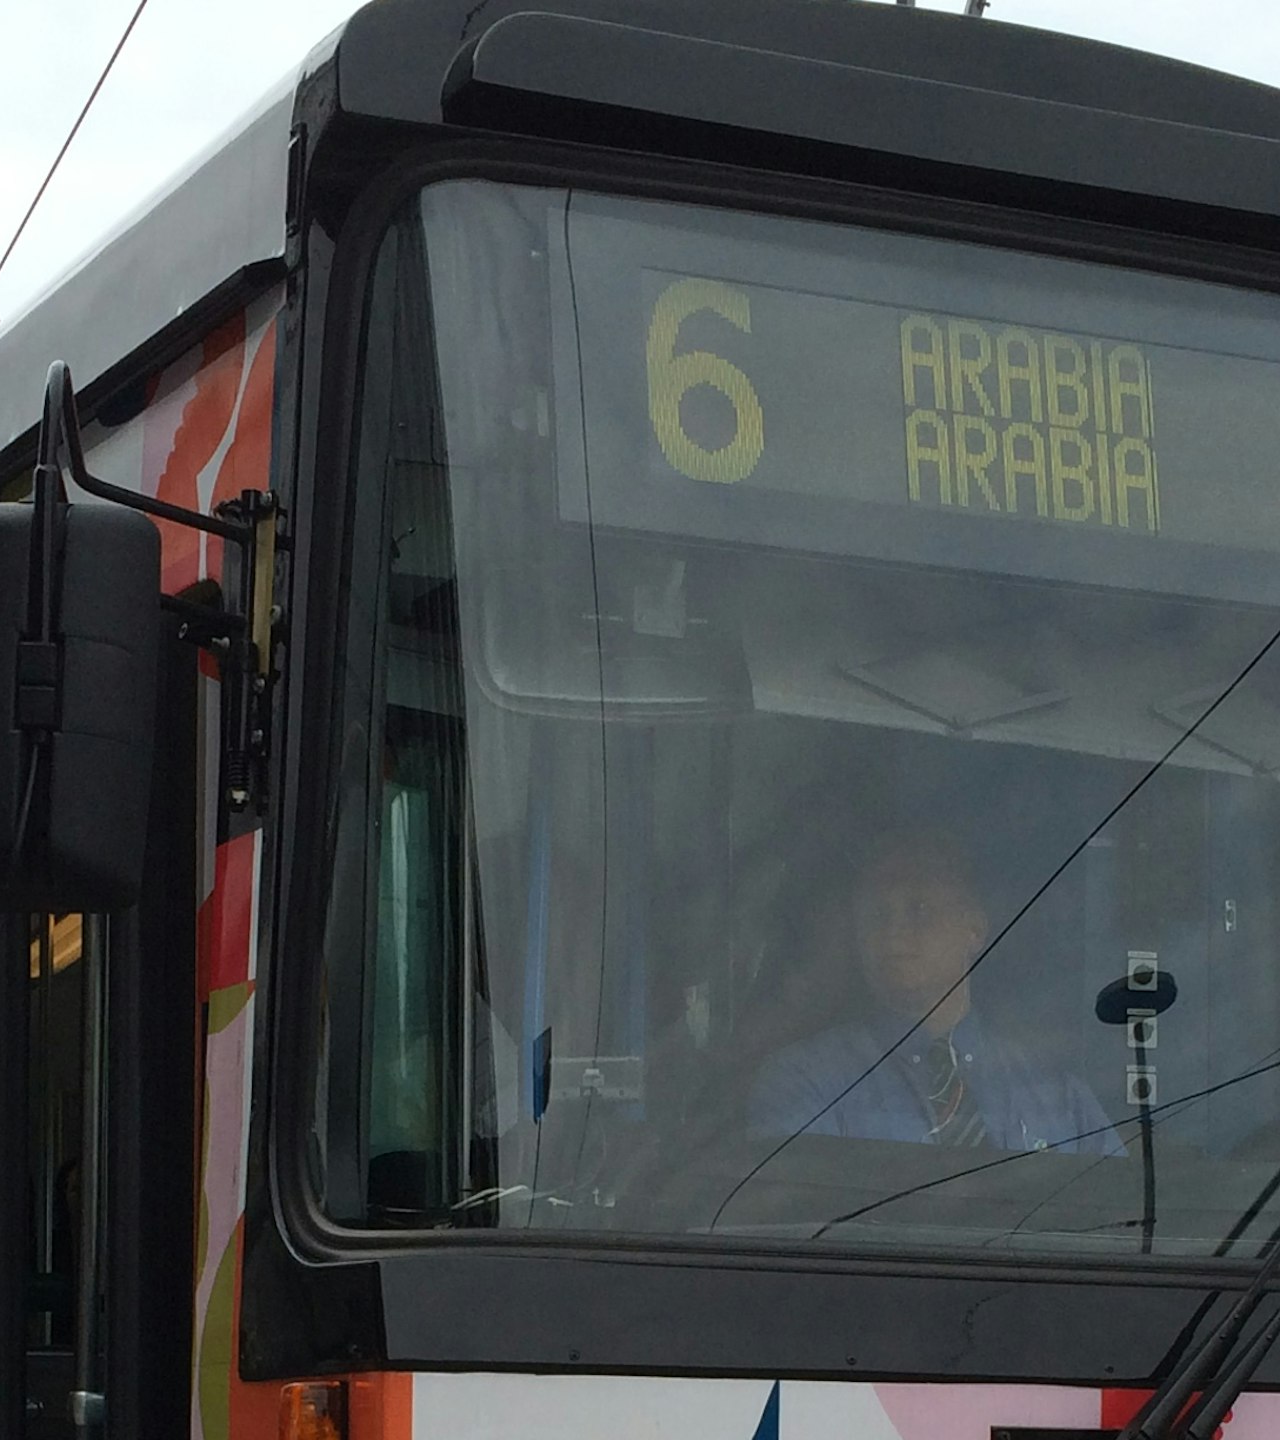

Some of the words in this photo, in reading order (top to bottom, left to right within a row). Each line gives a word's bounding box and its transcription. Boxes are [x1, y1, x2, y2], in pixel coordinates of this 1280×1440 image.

[646, 277, 764, 484] 6
[900, 314, 1154, 440] ARABIA
[906, 408, 1160, 530] ARABIA
